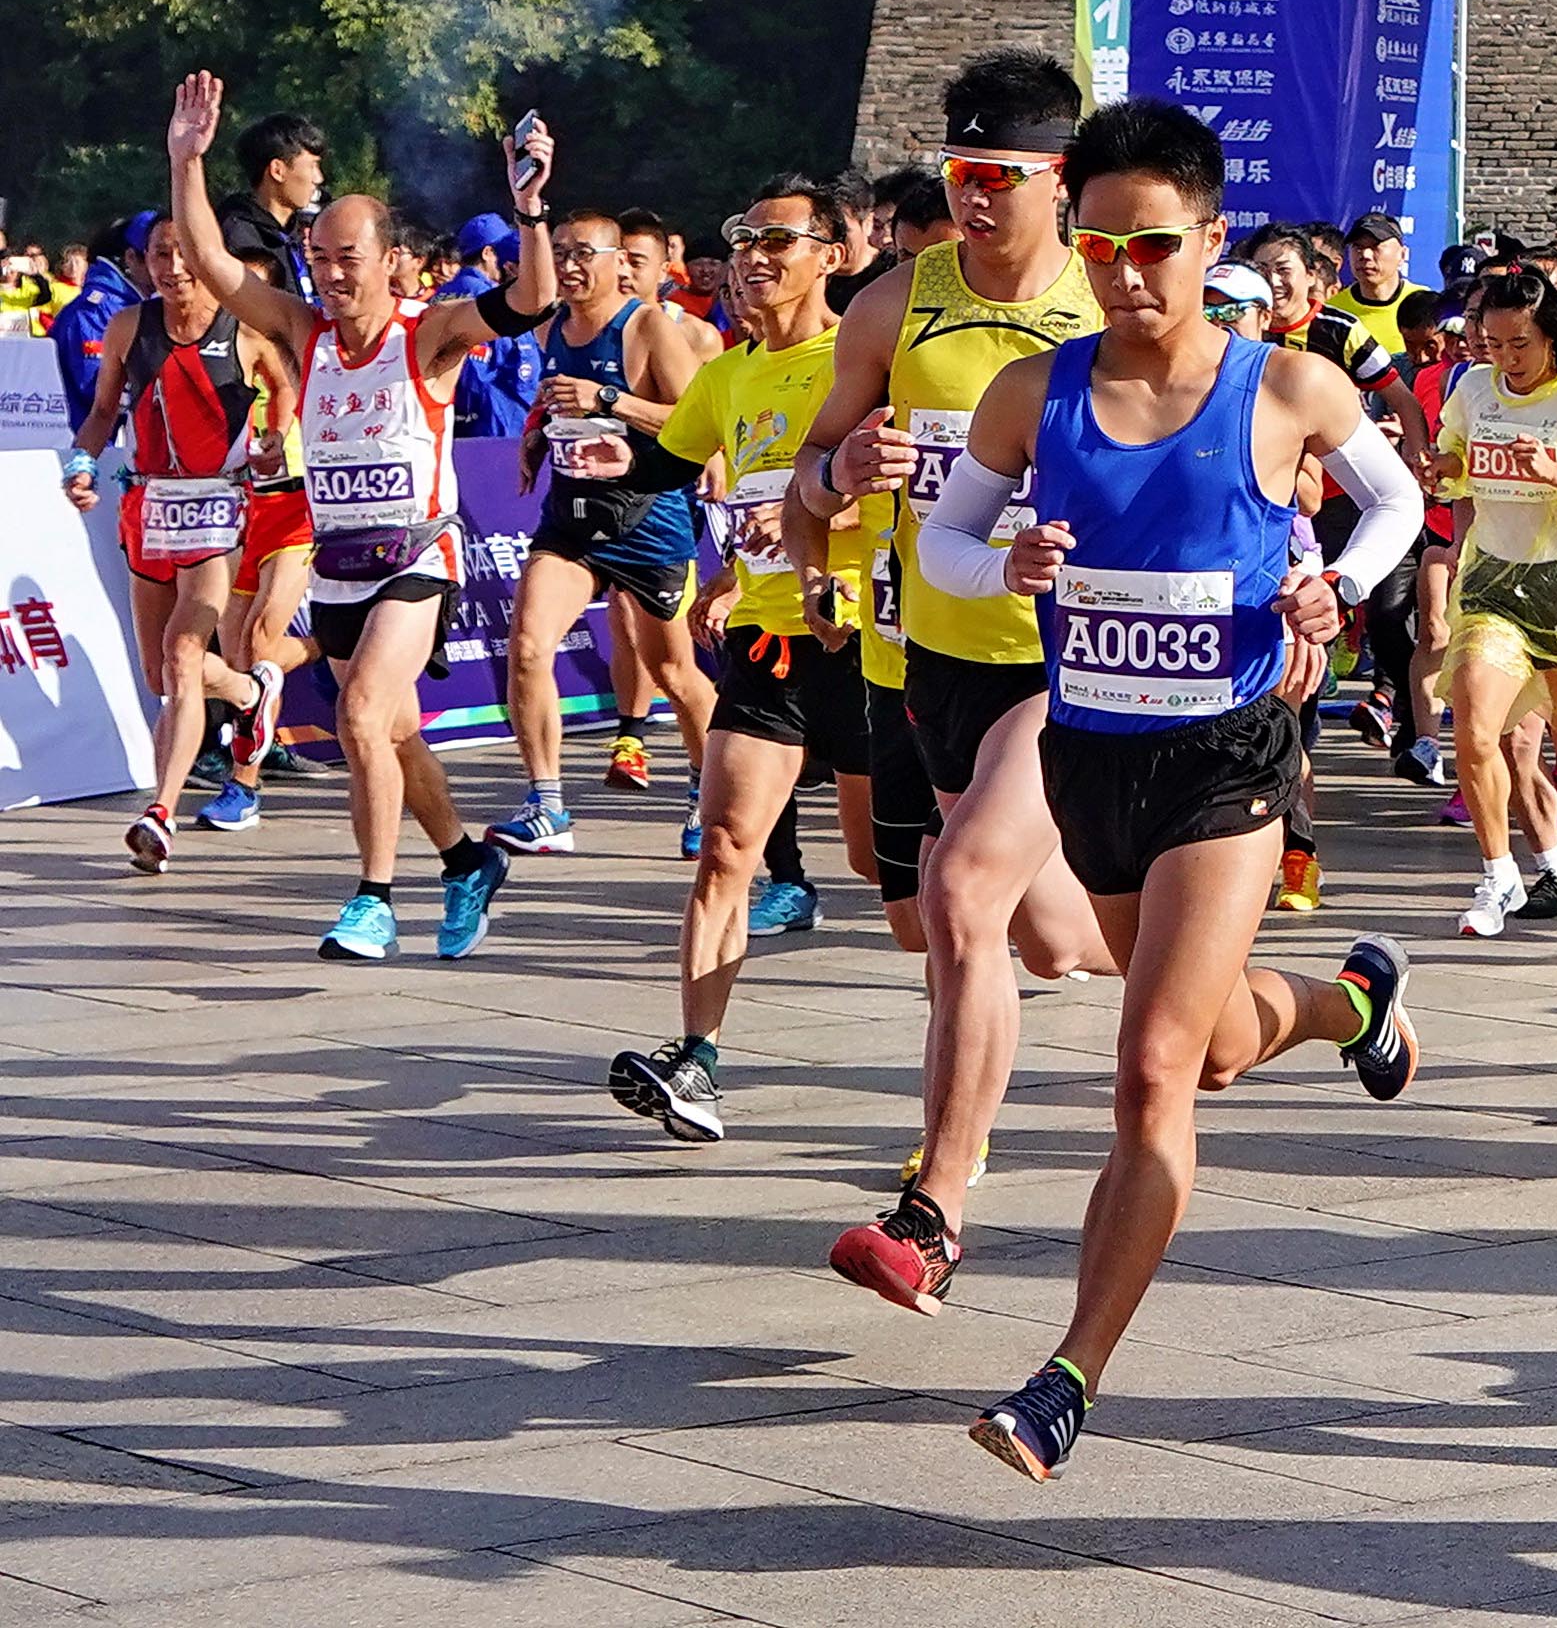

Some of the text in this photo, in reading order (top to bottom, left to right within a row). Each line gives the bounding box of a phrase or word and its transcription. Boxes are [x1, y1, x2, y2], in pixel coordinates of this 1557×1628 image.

[313, 466, 410, 501] A0432
[147, 499, 232, 529] A0648
[1061, 614, 1221, 672] A0033
